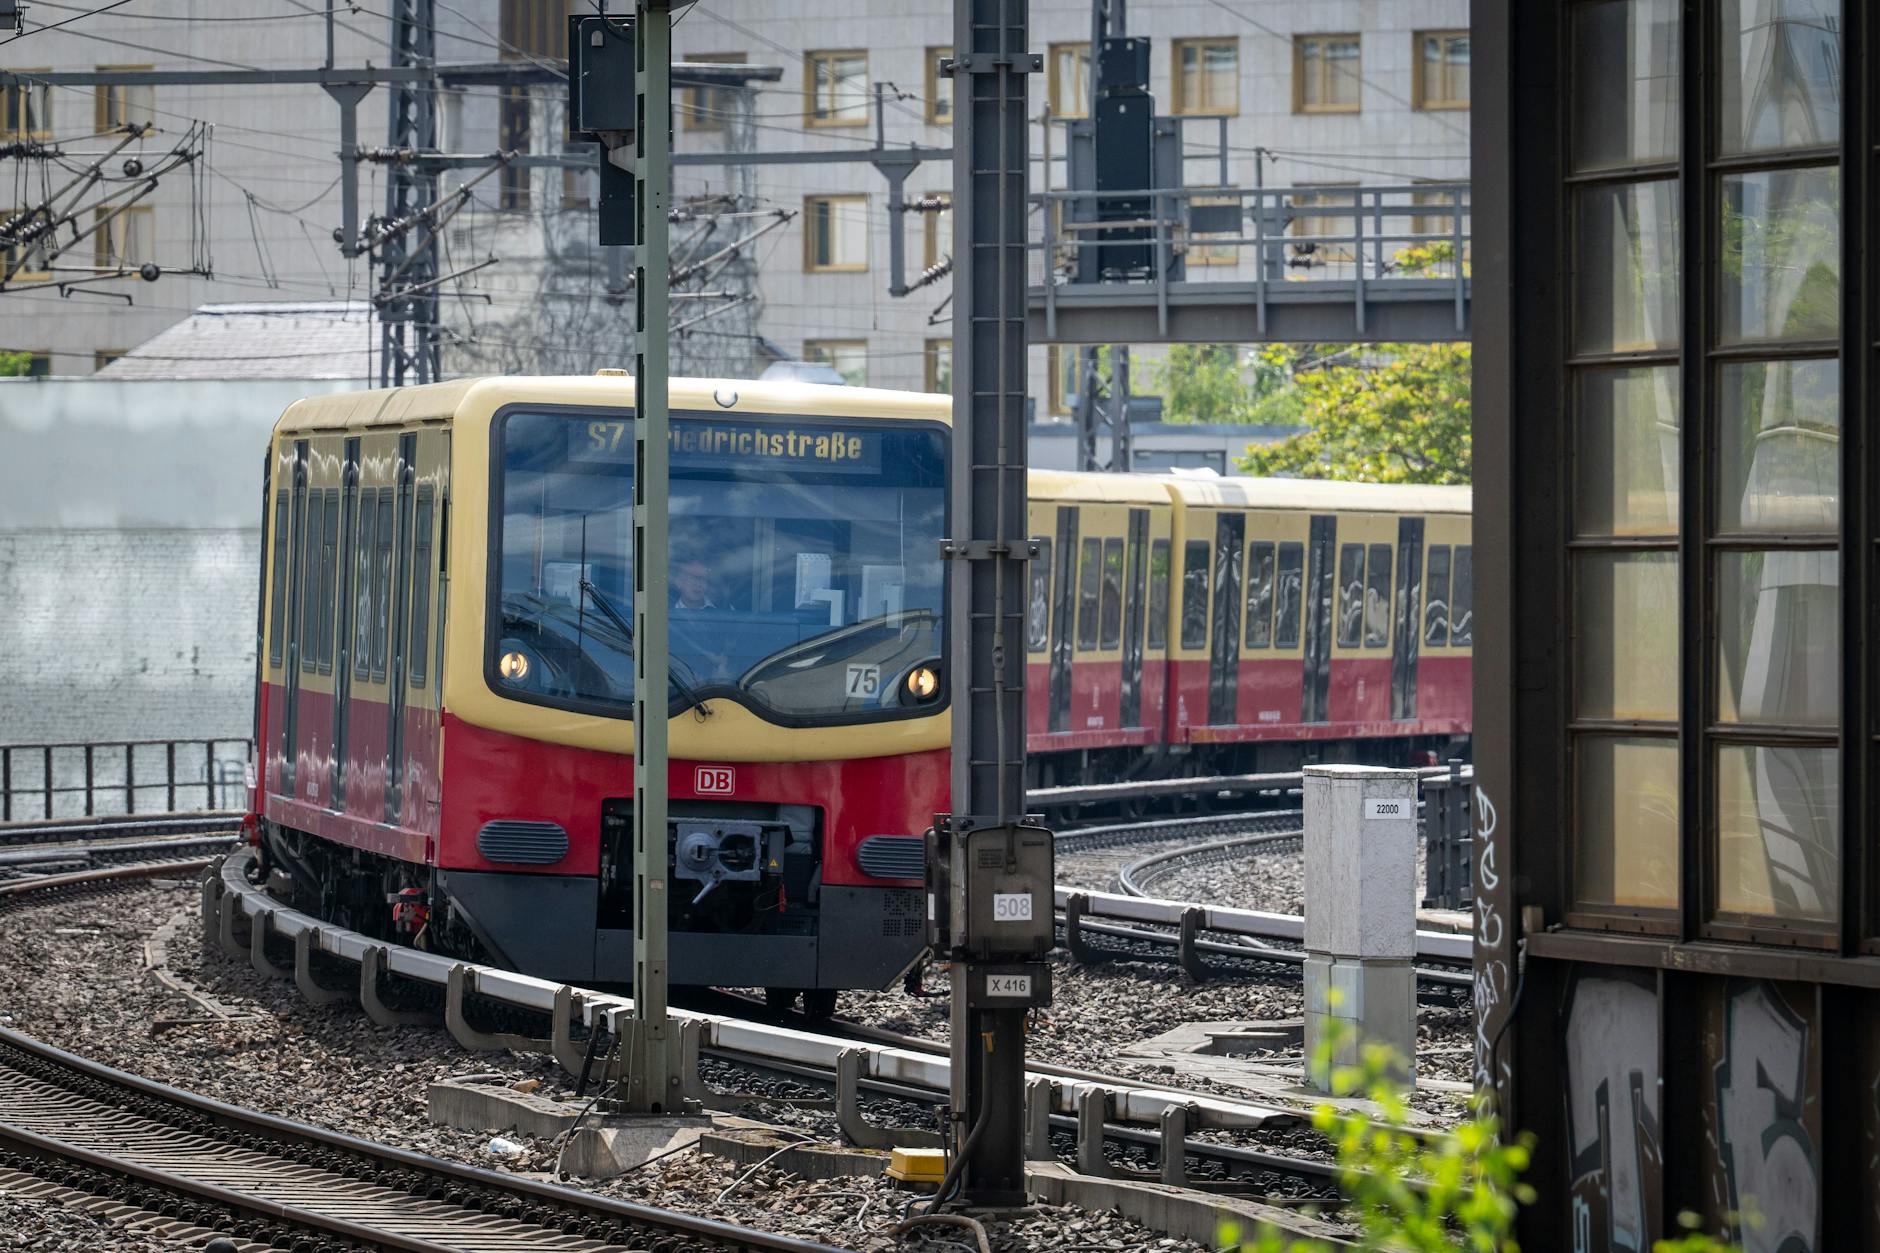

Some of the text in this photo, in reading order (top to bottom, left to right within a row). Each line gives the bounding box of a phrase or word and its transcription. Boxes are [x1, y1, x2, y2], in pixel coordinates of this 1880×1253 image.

[588, 422, 862, 461] S7 iedrichstraße
[850, 667, 878, 694] 75
[698, 769, 732, 792] DB
[1376, 804, 1399, 814] 22000
[996, 897, 1030, 917] 508
[992, 979, 1026, 991] X 416
